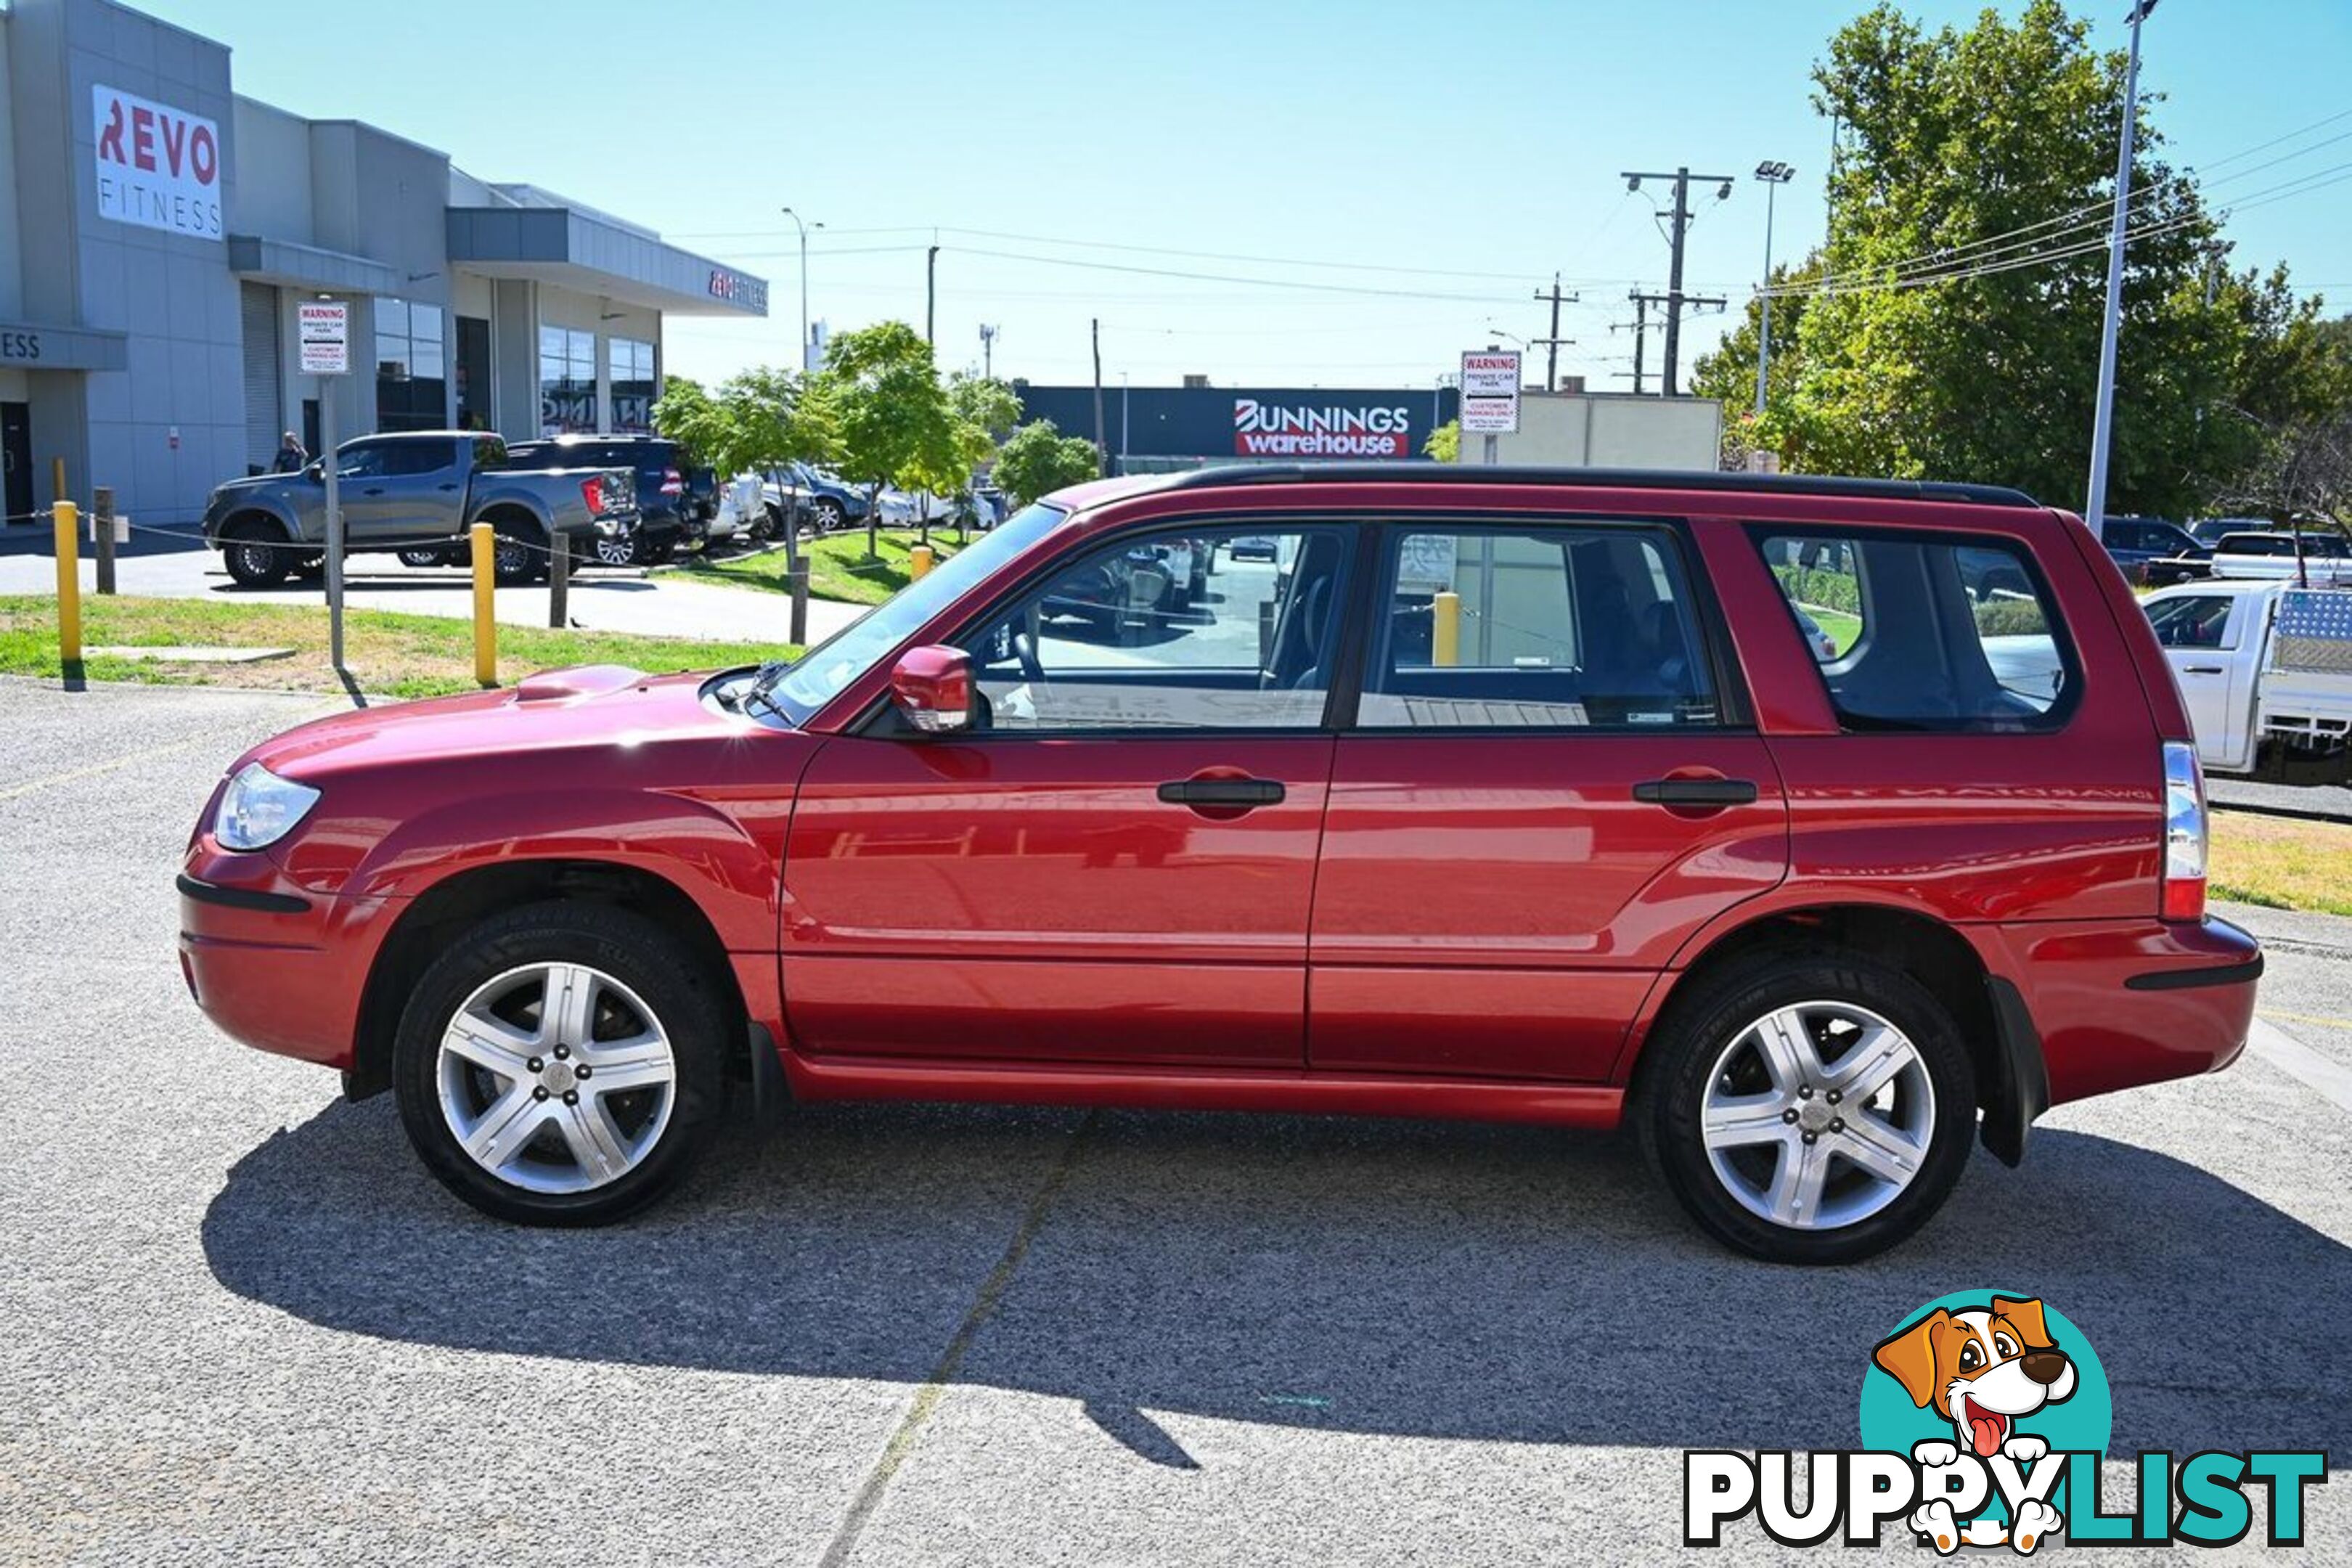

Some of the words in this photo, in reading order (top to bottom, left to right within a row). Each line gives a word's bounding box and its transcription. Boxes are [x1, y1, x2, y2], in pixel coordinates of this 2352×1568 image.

[99, 98, 216, 186] REVO
[100, 178, 220, 234] FITNESS
[302, 309, 343, 319] WARNING
[1467, 358, 1515, 369] WARNING
[1235, 399, 1409, 433] BUNNINGS
[1244, 425, 1397, 454] warehouse
